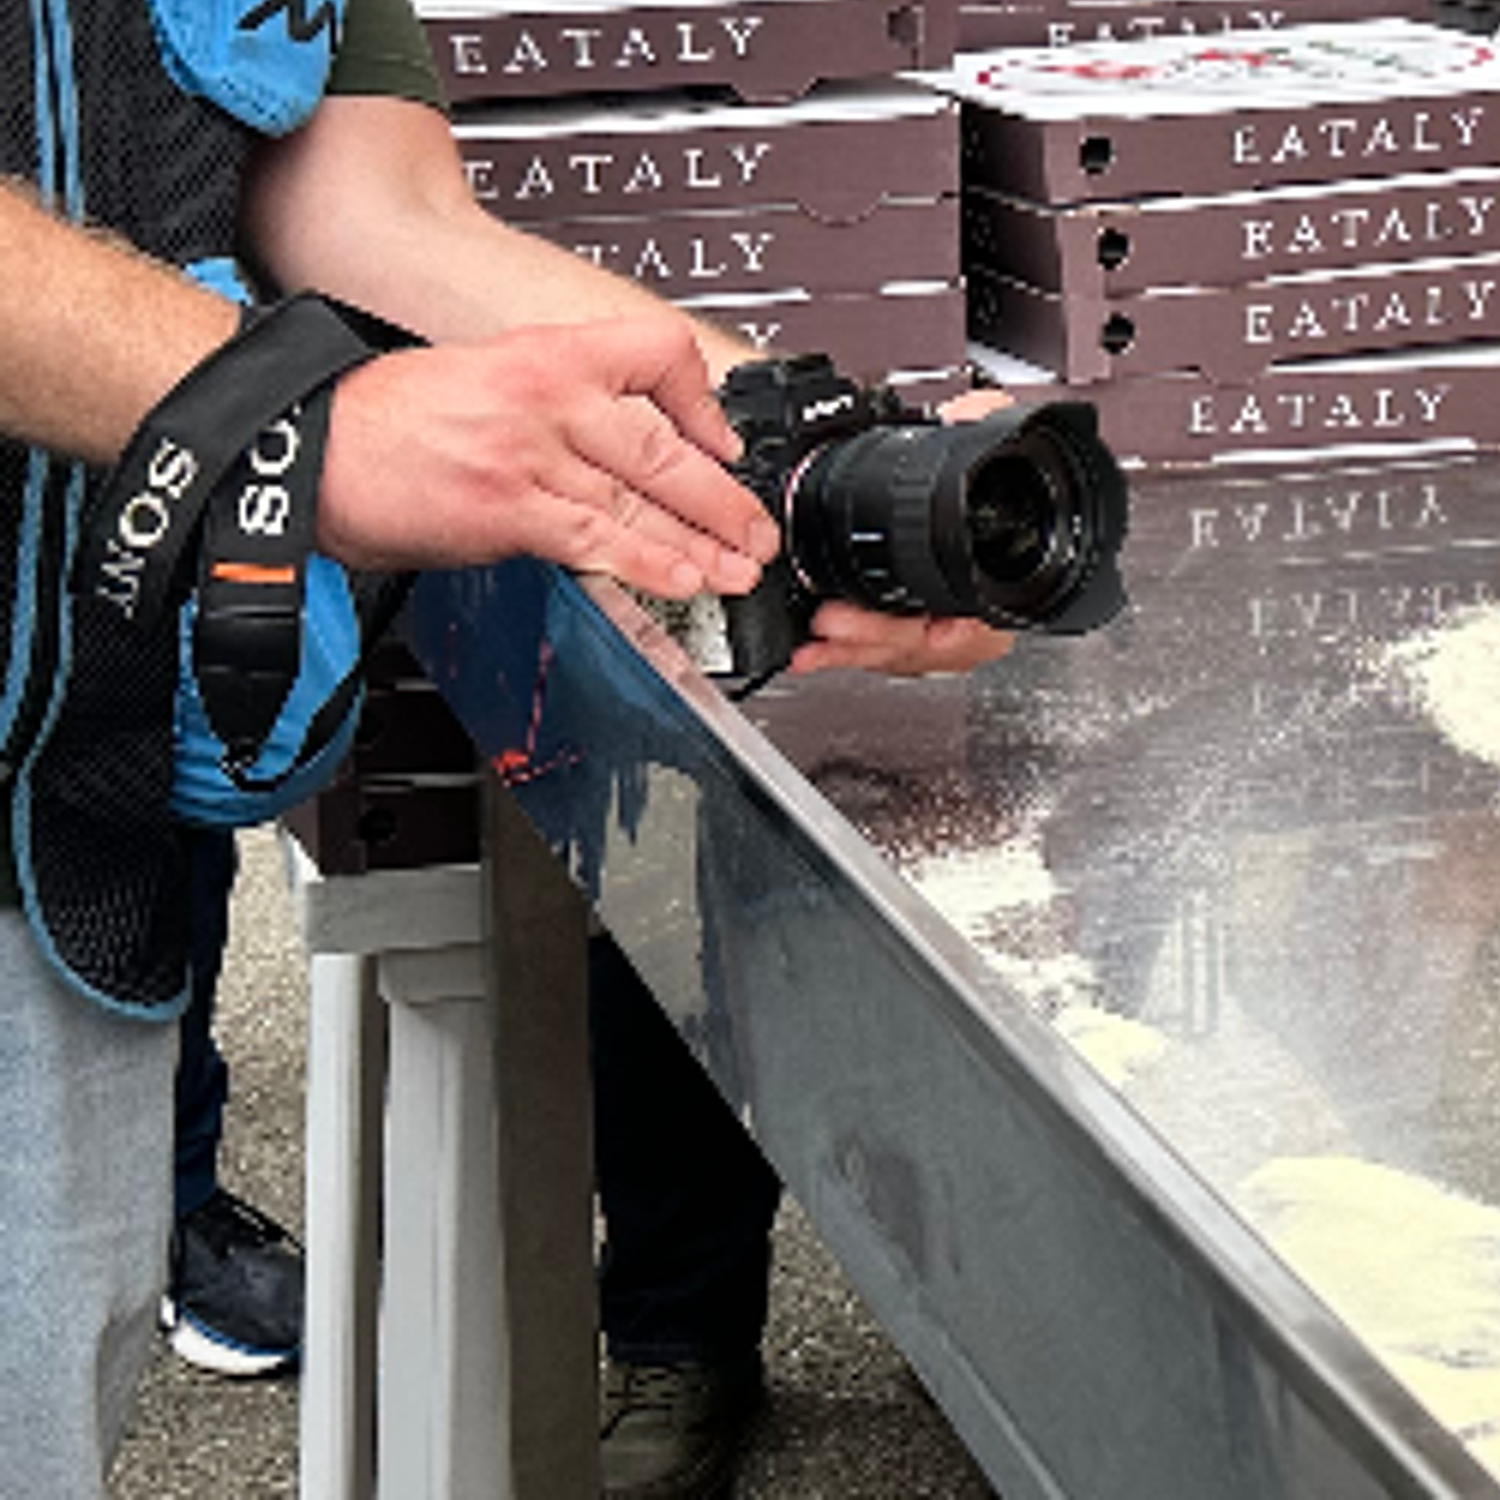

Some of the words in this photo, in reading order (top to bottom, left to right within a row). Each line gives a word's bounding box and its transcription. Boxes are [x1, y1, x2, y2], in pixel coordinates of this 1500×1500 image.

[448, 17, 764, 75] EATALY
[1232, 106, 1487, 165] EATALY
[1241, 197, 1497, 259] EATALY
[1243, 281, 1498, 344] EATALY
[1186, 386, 1450, 435] EATALY
[96, 437, 200, 619] SONY
